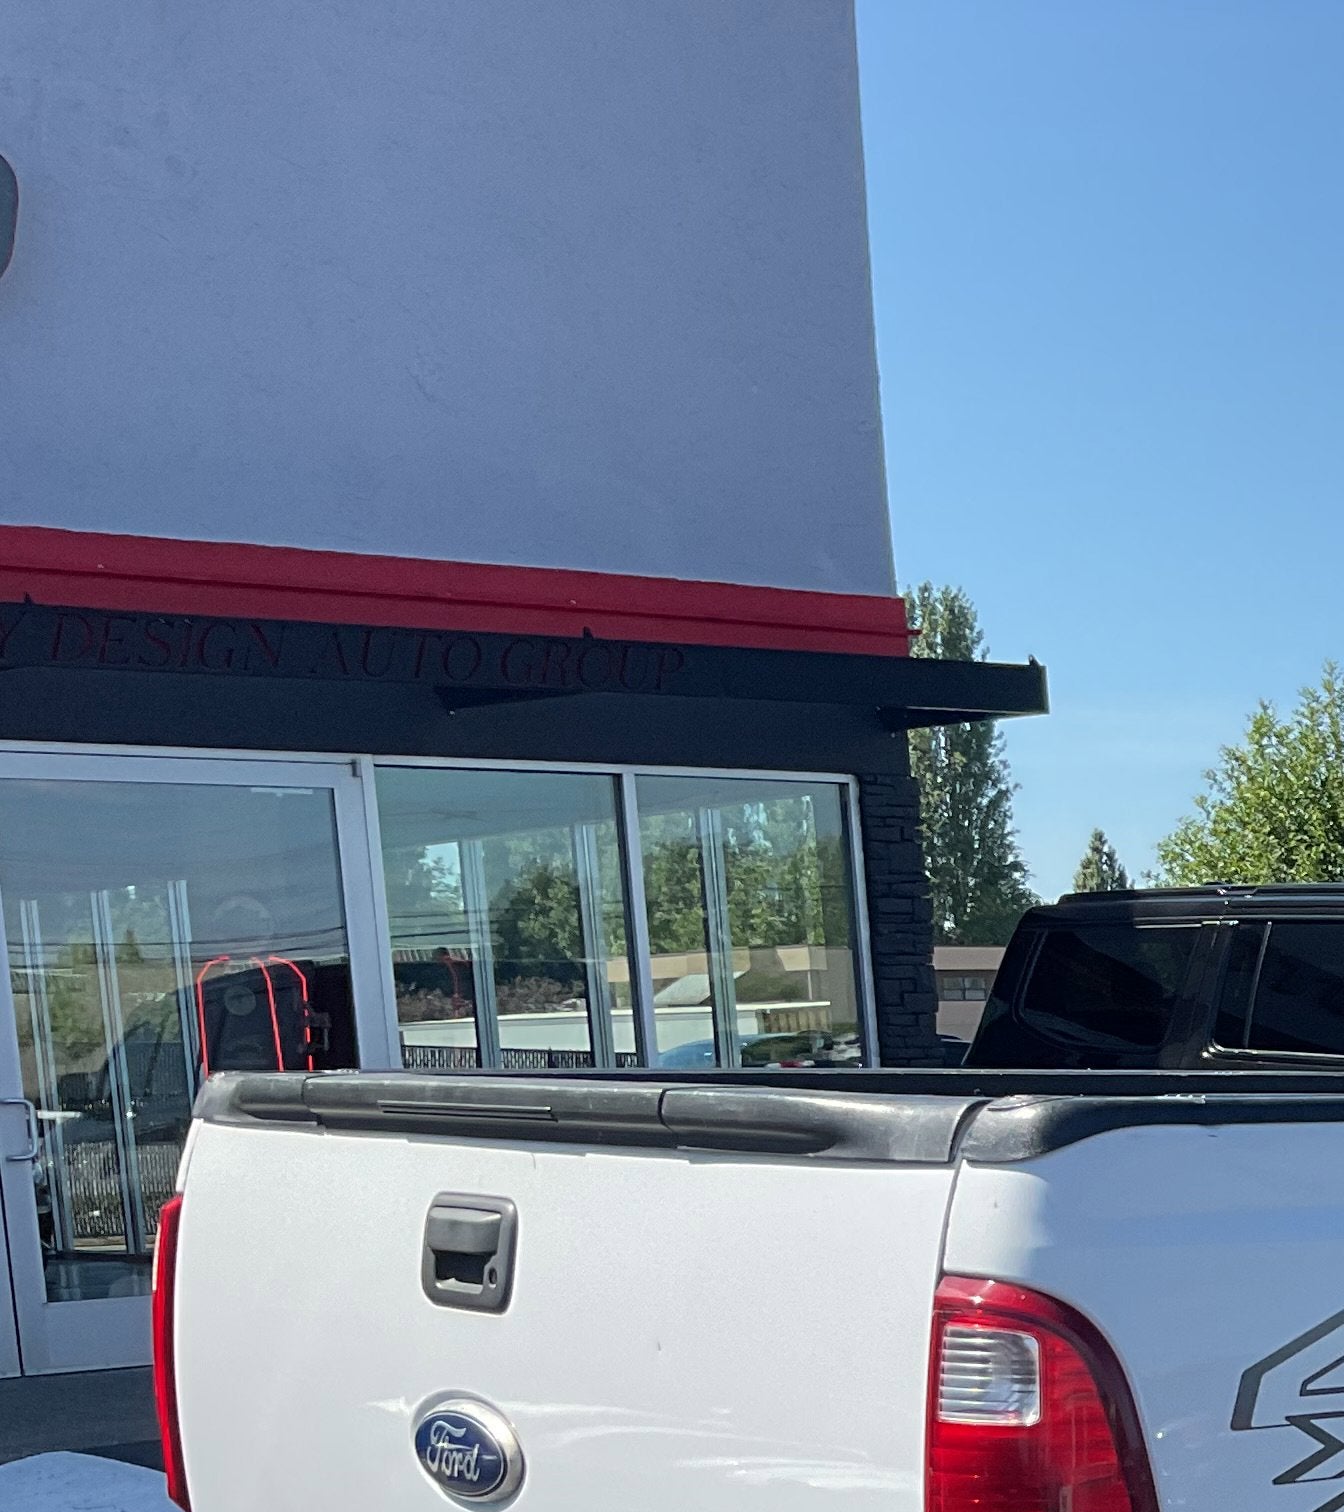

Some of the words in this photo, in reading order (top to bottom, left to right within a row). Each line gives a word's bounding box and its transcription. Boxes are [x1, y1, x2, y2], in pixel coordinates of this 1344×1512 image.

[50, 612, 288, 672] DESIGN
[310, 627, 482, 681] AUTO
[500, 637, 685, 690] GROUP
[426, 1420, 480, 1482] Ford
